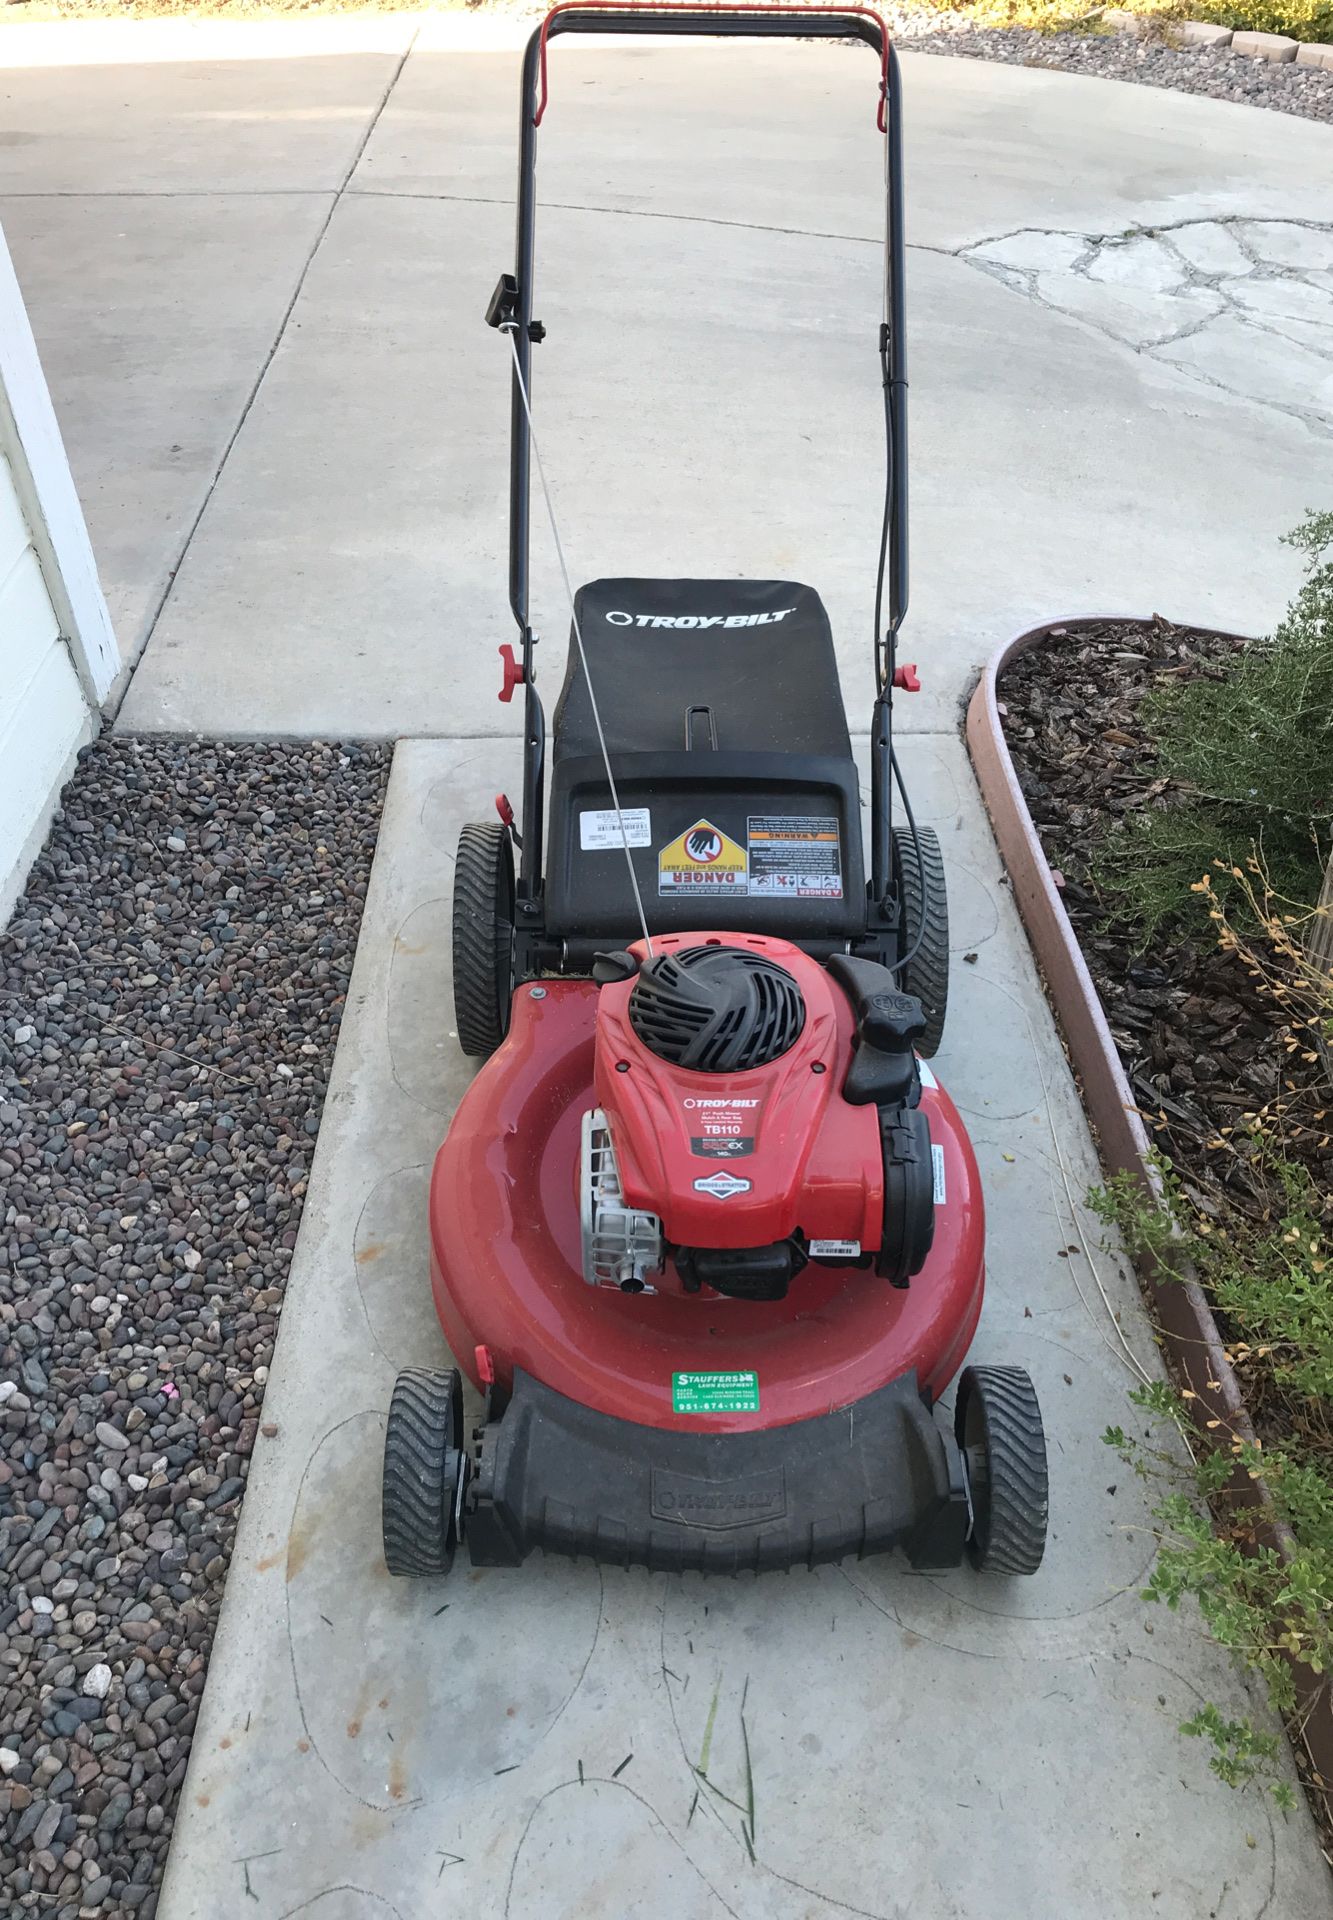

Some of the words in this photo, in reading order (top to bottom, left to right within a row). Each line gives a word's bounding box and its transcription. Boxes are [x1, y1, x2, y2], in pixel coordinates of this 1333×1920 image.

[635, 609, 792, 629] TROY-BILT
[672, 872, 735, 883] DANGER
[799, 888, 832, 896] DANGER
[696, 1099, 760, 1108] TROY-BILT
[704, 1125, 741, 1134] TB110
[678, 1374, 738, 1386] STAUFFERS
[678, 1402, 756, 1411] 951-674-1922
